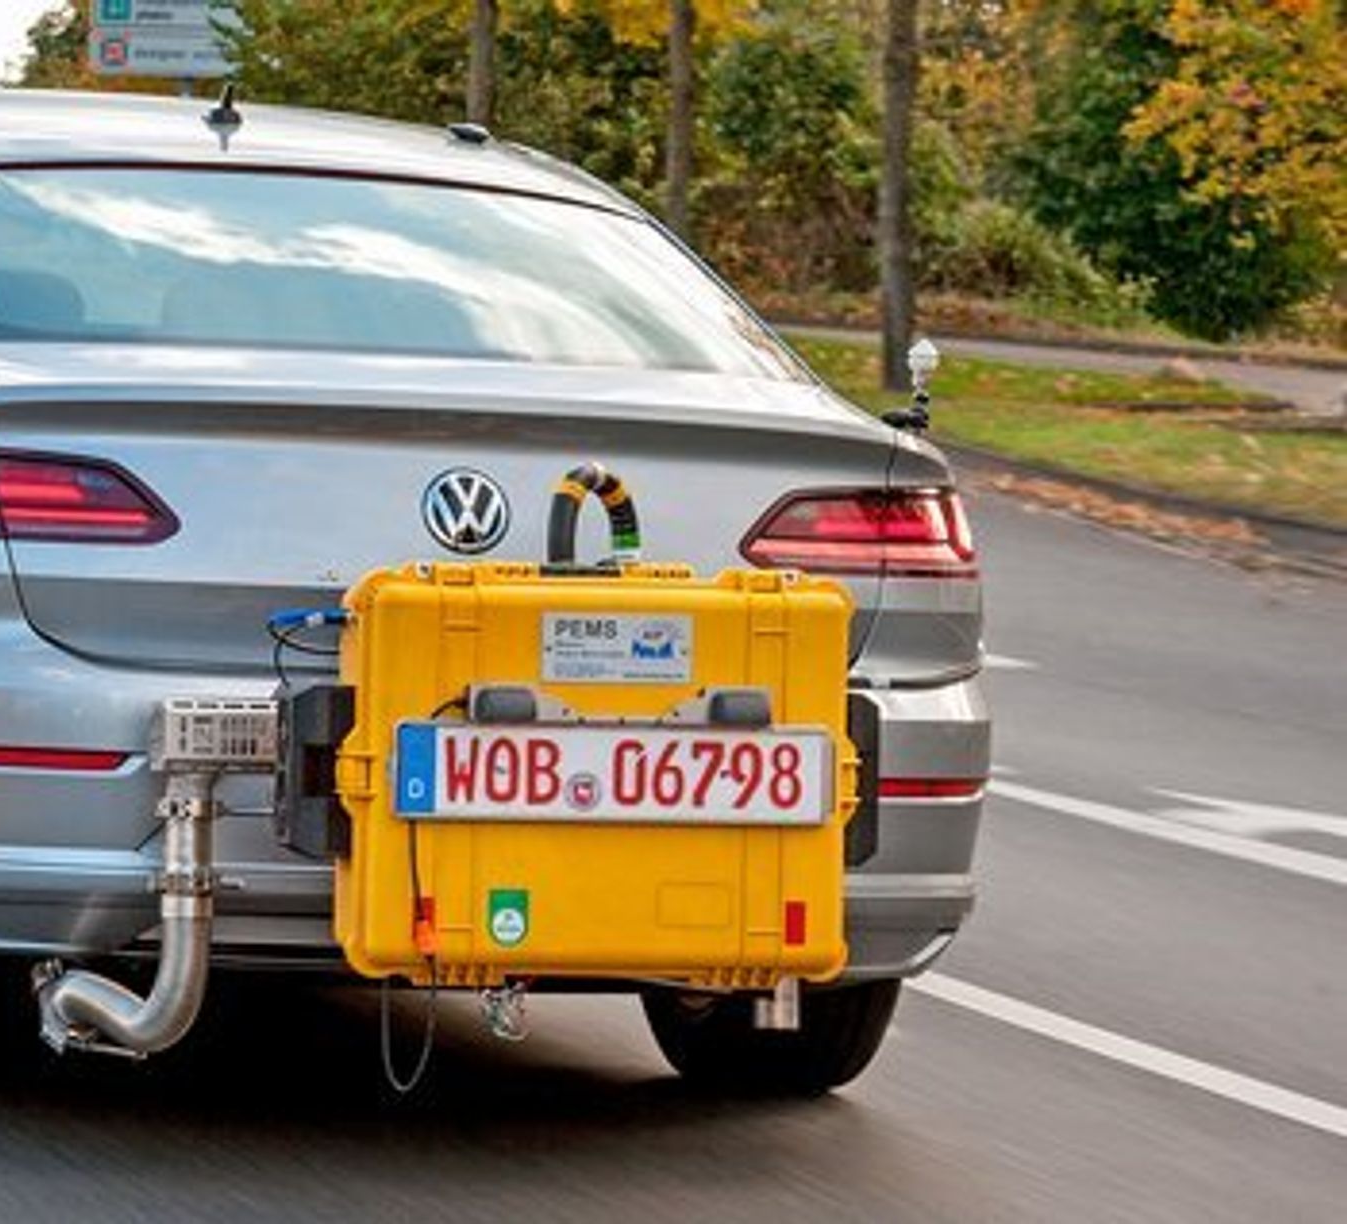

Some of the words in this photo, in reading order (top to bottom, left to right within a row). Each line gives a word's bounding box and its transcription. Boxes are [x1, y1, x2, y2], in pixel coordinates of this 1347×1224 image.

[554, 618, 618, 639] PEMS
[407, 777, 425, 799] D
[443, 736, 562, 805] WOB
